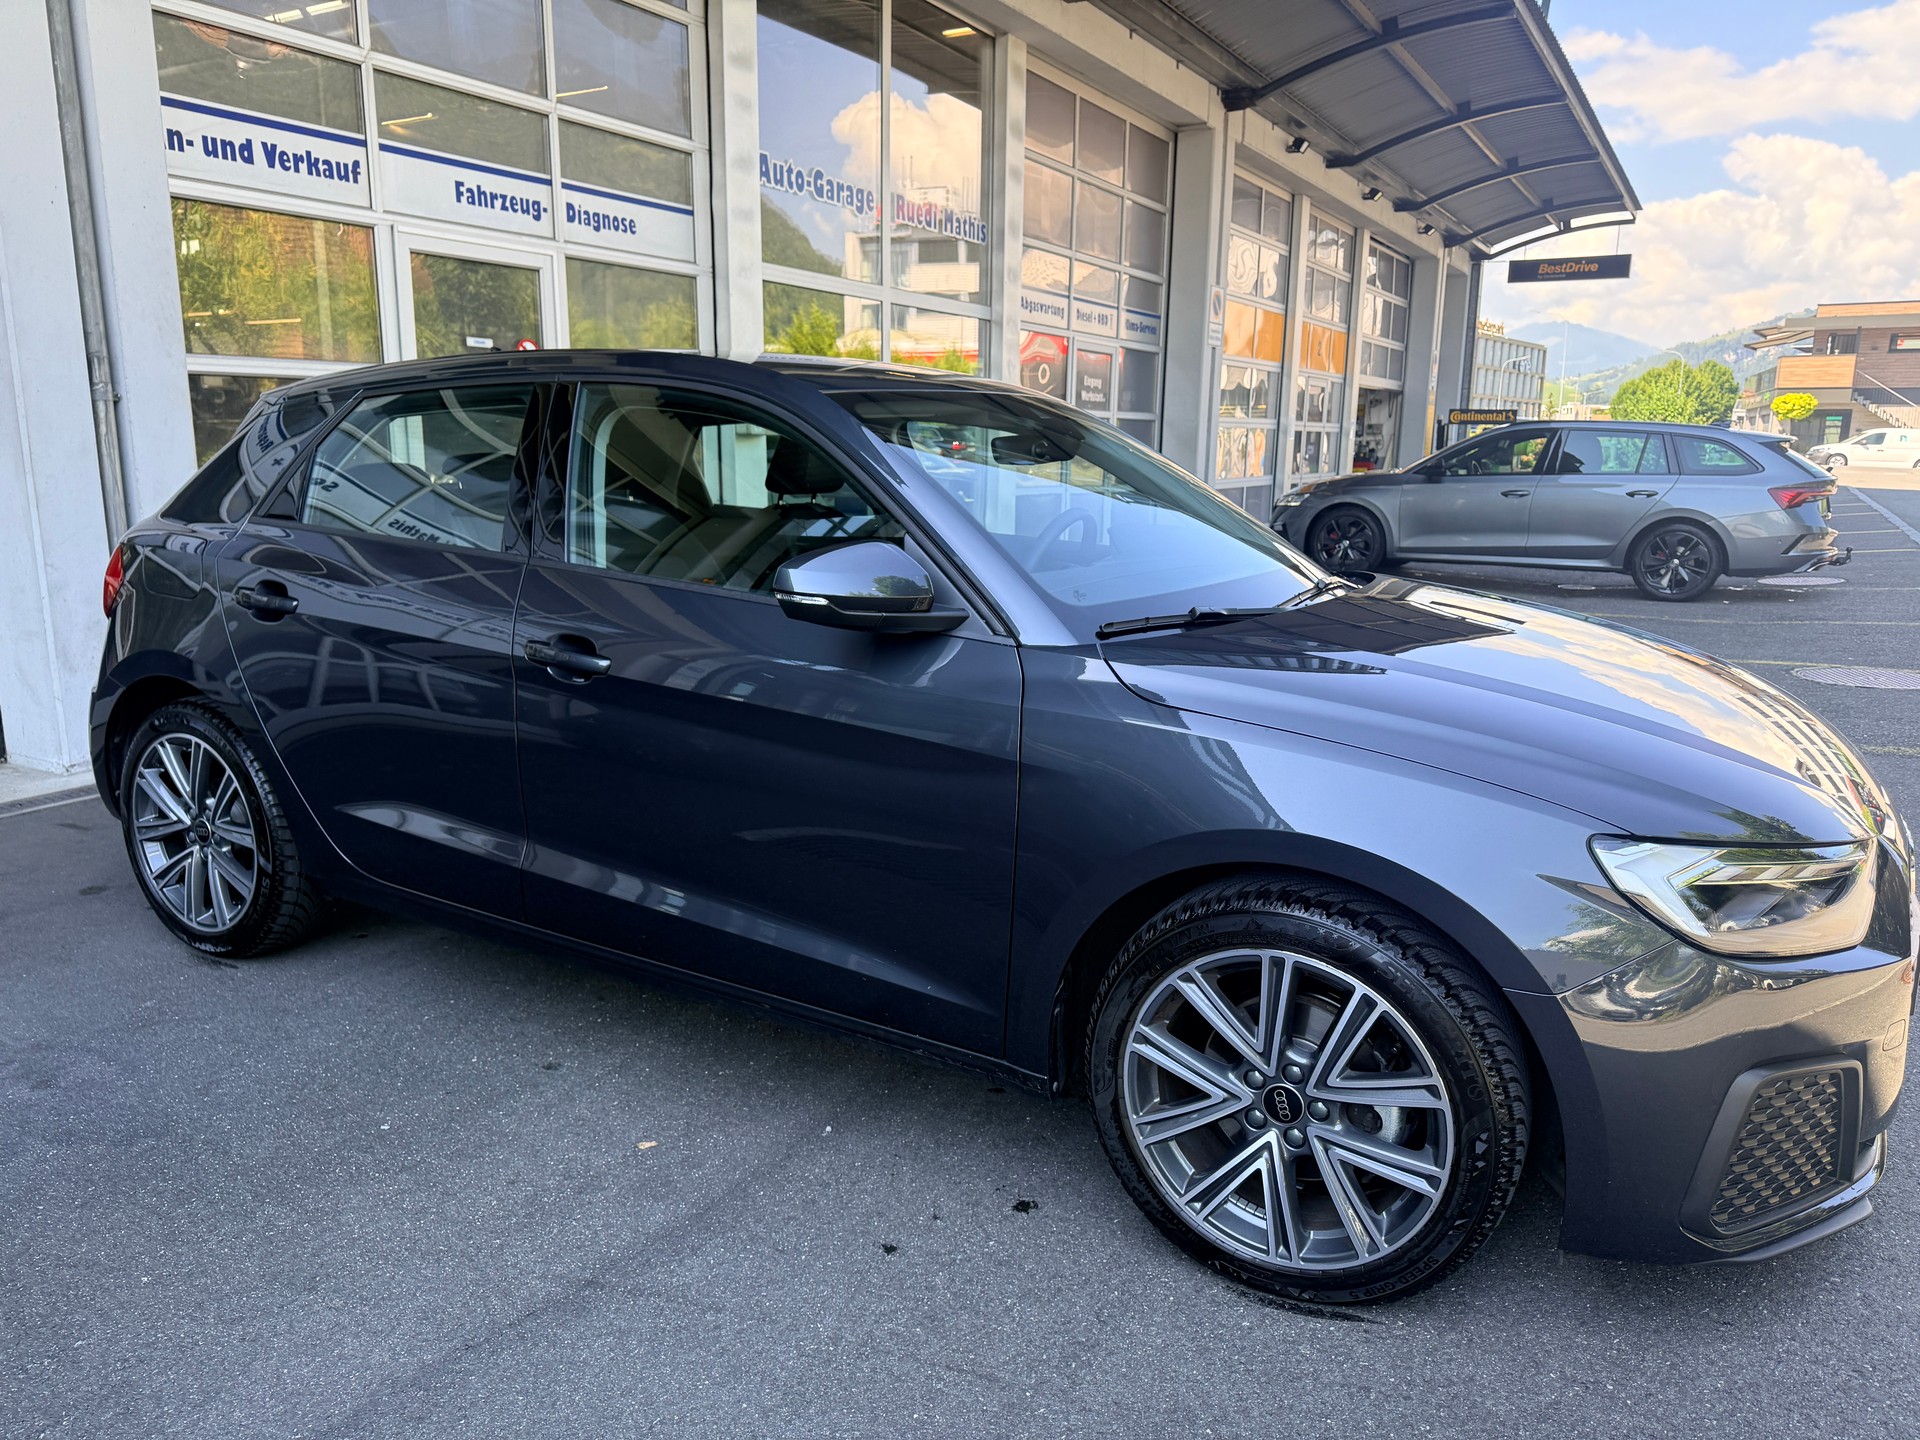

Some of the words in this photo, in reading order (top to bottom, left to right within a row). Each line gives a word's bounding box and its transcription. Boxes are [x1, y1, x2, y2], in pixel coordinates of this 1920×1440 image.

[164, 127, 194, 152] n-
[201, 135, 254, 165] und
[260, 141, 361, 184] Verkauf
[759, 152, 874, 215] Auto-Garage
[896, 194, 937, 230] Ruedi
[944, 209, 987, 243] Mathis
[454, 180, 548, 221] Fahrzeug-
[566, 202, 637, 235] Diagnose
[1538, 261, 1598, 274] BestDrive
[1076, 308, 1093, 323] Diesel
[1450, 410, 1506, 423] Continental
[1349, 1290, 1359, 1300] 5
